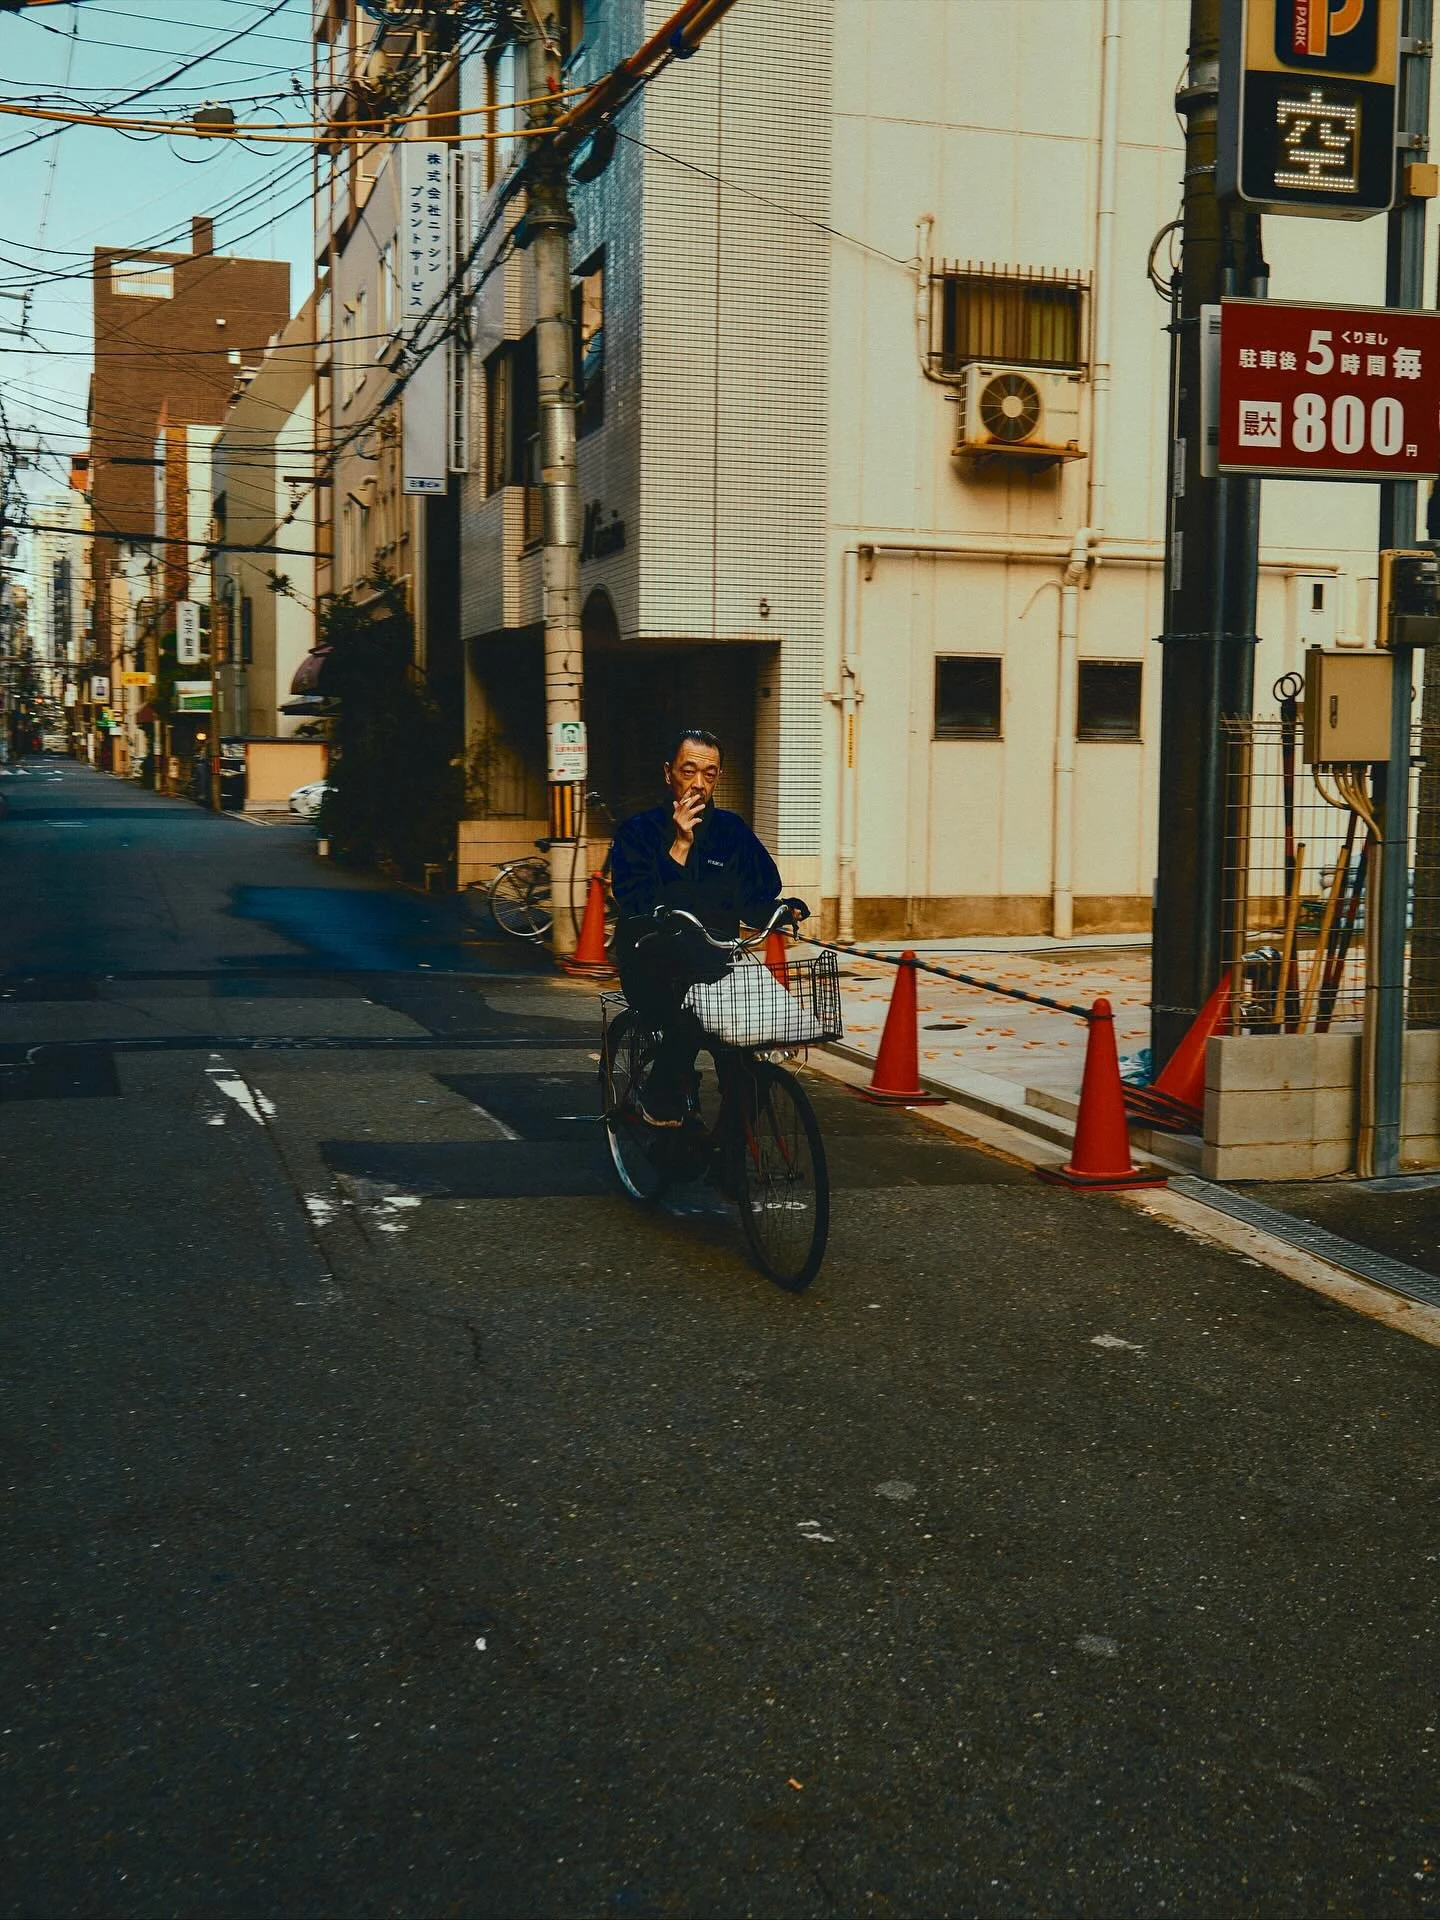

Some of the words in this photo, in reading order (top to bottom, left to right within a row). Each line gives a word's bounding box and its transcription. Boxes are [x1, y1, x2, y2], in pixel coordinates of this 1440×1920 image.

[1295, 6, 1308, 47] PARK
[1274, 92, 1357, 189] 空
[409, 185, 424, 306] プラントサービス
[427, 153, 441, 272] 株式会社ニッシン
[1341, 331, 1389, 345] くり返し
[1244, 410, 1277, 437] 最大
